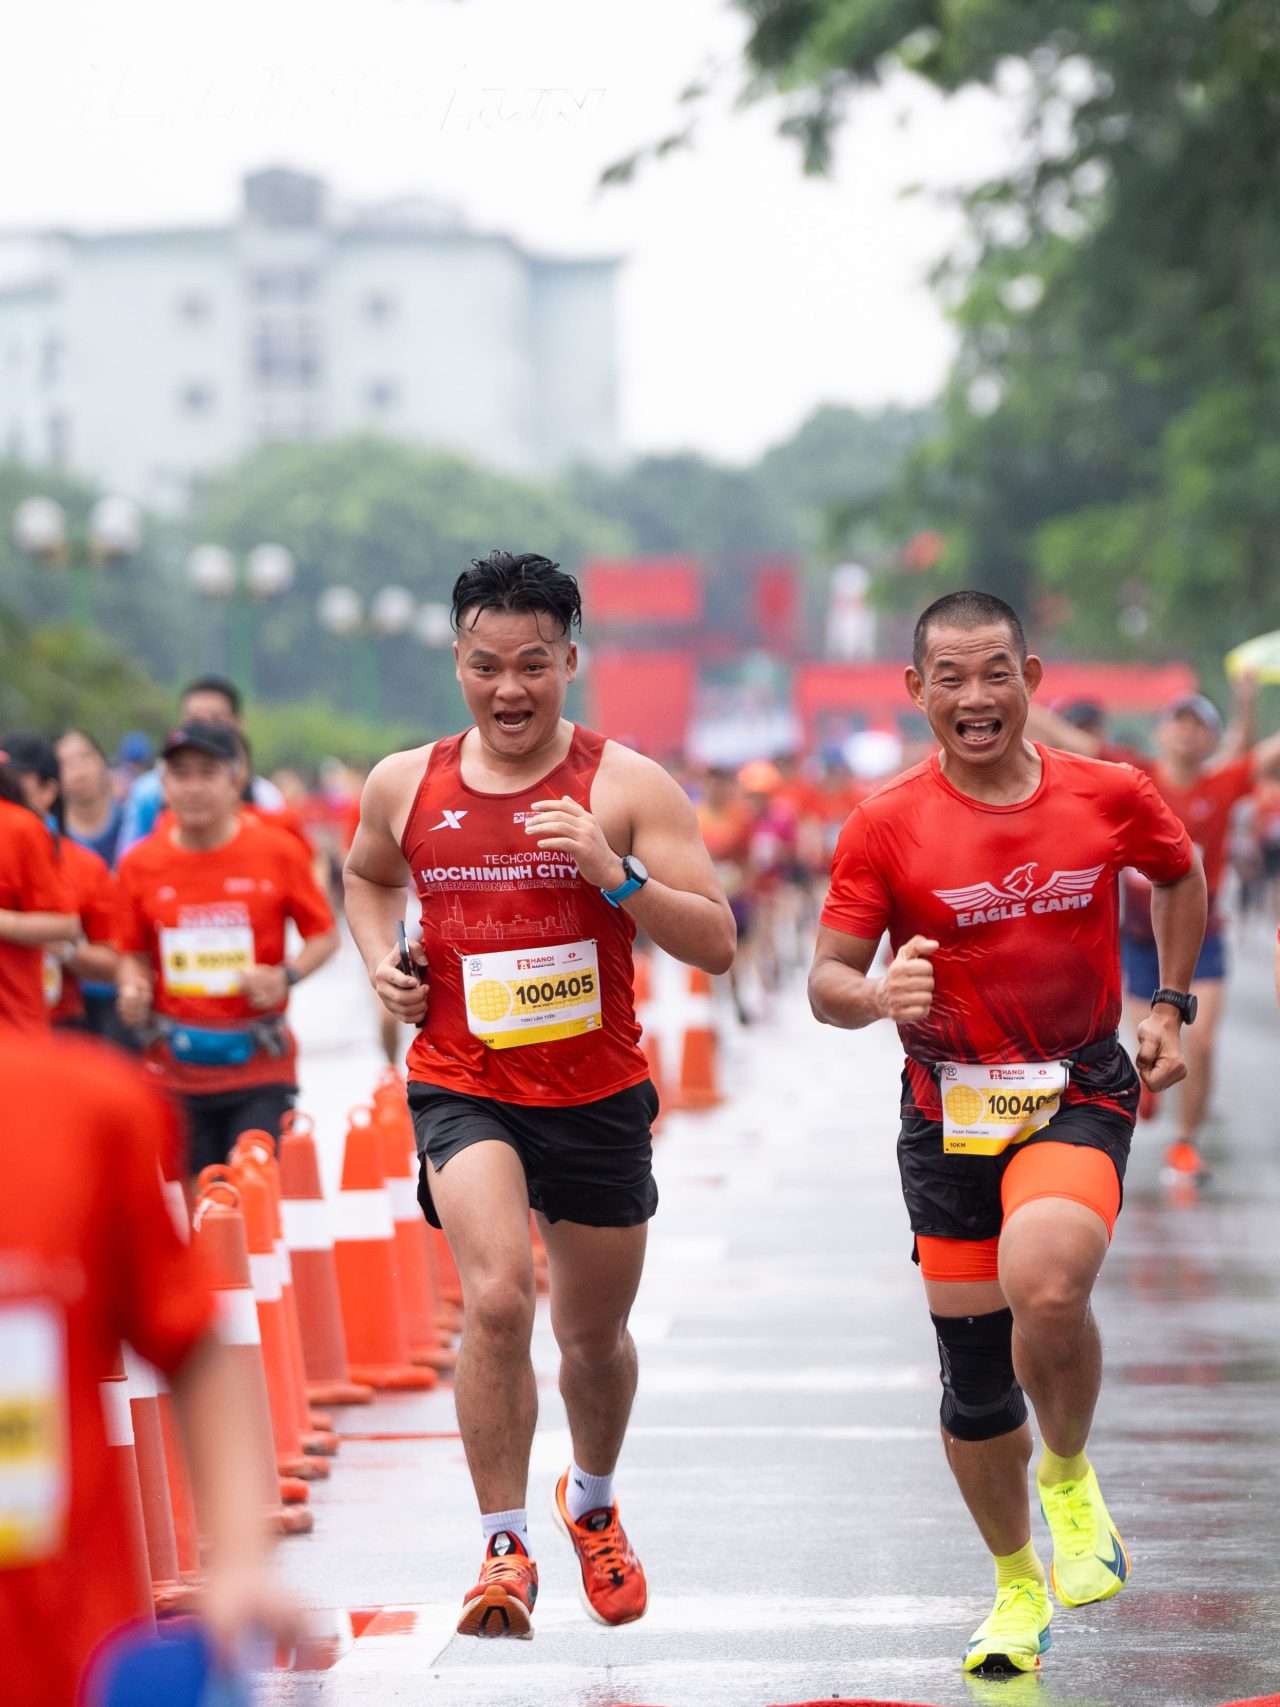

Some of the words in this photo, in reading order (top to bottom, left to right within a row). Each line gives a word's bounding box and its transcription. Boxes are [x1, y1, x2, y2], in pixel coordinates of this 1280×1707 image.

[483, 851, 577, 865] TECHCOMBANK
[421, 865, 533, 883] HOCHIMINH
[536, 864, 579, 879] CITY
[426, 880, 516, 893] INTERNATIONAL
[518, 878, 581, 890] MARATHON
[956, 902, 1027, 928] EAGLE
[1031, 893, 1093, 914] CAMP
[516, 974, 594, 1005] 100405
[988, 1093, 1056, 1116] 10040
